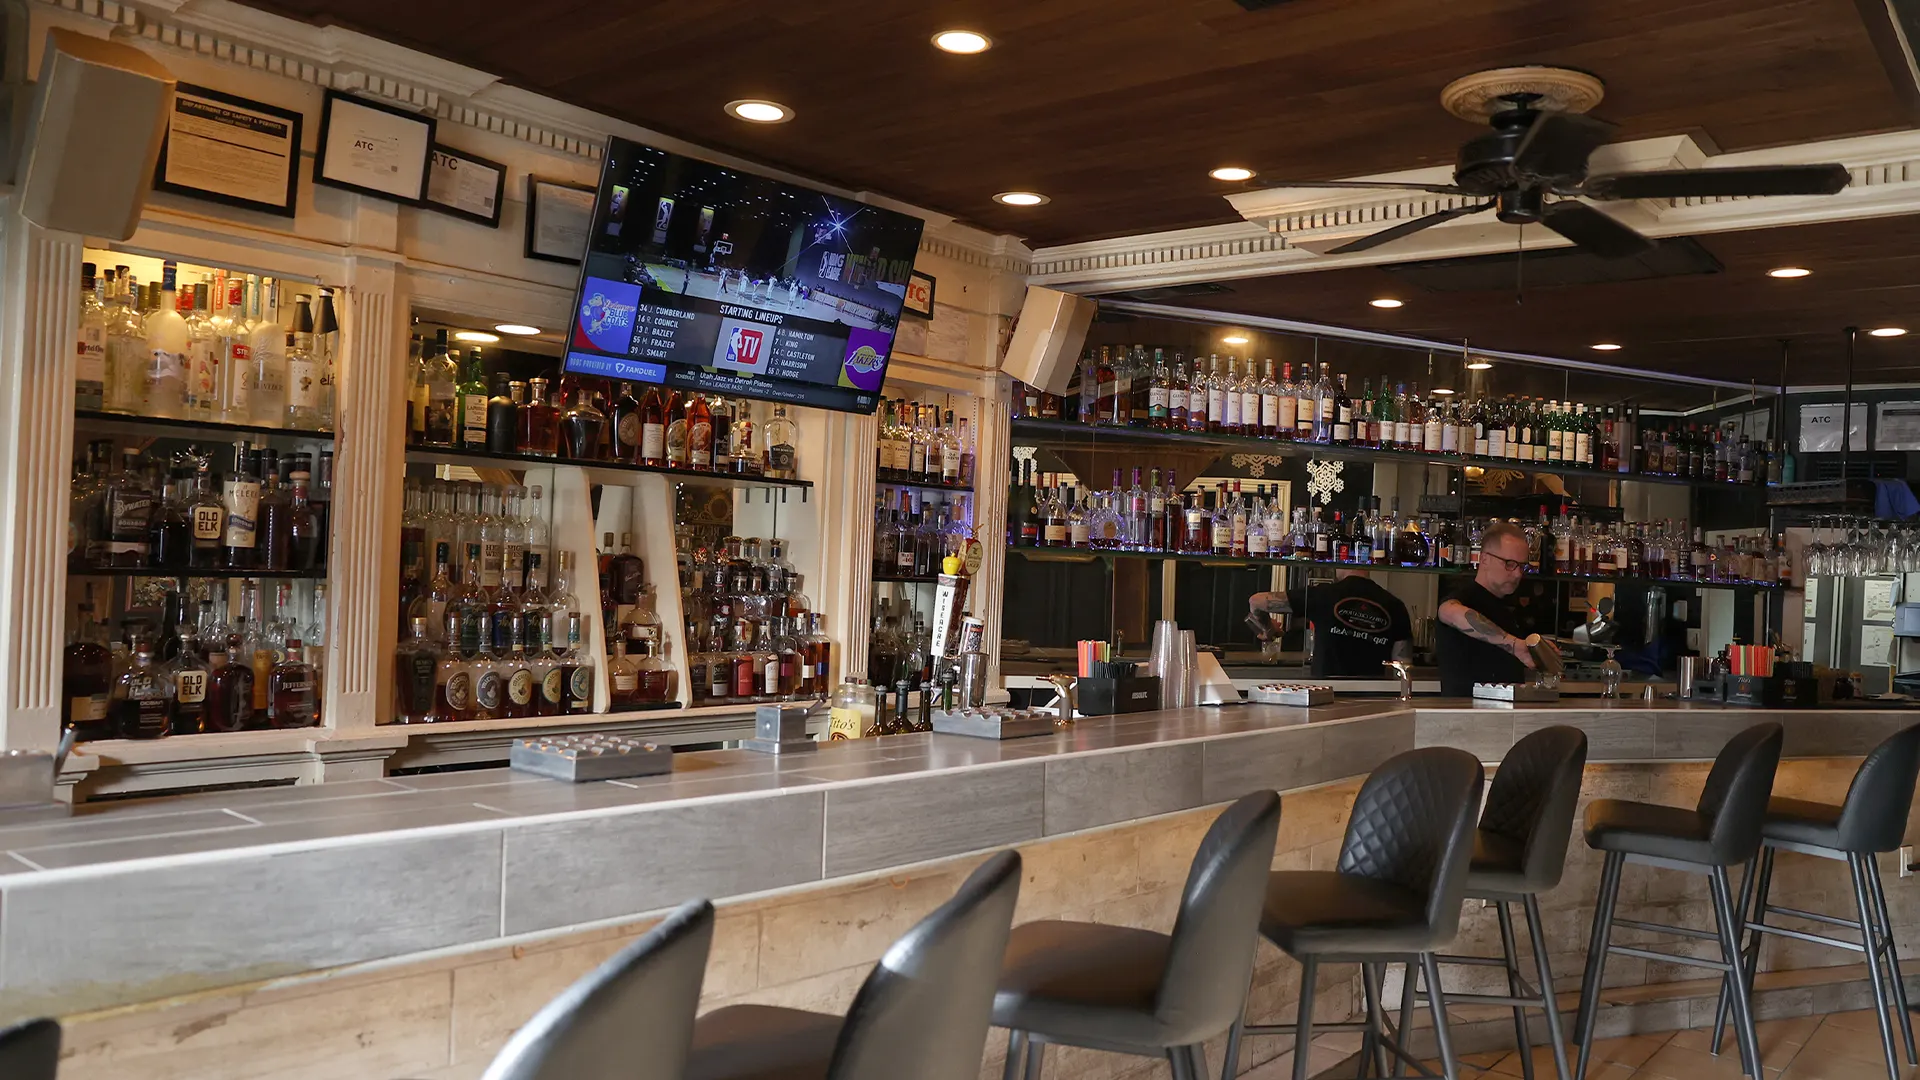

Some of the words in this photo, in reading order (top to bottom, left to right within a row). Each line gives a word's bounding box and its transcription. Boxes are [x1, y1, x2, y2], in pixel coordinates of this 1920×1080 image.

[232, 112, 253, 123] SAFETY
[354, 140, 374, 151] ATC
[431, 153, 458, 171] ATC
[908, 283, 926, 303] TC
[610, 309, 628, 319] BLUE
[640, 304, 648, 312] 34
[656, 306, 695, 320] CUMBERLAND
[719, 304, 753, 320] STARTING
[754, 310, 784, 325] LINEUPS
[606, 316, 628, 328] COATS
[638, 315, 646, 323] 16
[654, 318, 679, 328] COUNCIL
[652, 328, 674, 338] BAZLEY
[788, 331, 814, 341] HAMILTON
[632, 336, 641, 344] 55
[650, 338, 676, 350] FRAZIER
[742, 336, 760, 358] TV
[785, 340, 799, 349] KING
[630, 346, 639, 354] 39
[647, 348, 667, 358] SMART
[786, 350, 815, 361] CASTLETON
[781, 360, 808, 370] HARRISON
[845, 351, 885, 371] LAKERS
[625, 366, 657, 377] FANDUEL
[675, 372, 695, 381] SCHEDULE
[781, 369, 800, 378] HODGE
[700, 372, 714, 381] Utah
[714, 375, 727, 383] Jazz
[734, 376, 753, 386] Detroit
[753, 380, 773, 389] Pistons
[713, 381, 731, 390] LEAGUE
[1811, 416, 1831, 424] ATC
[199, 512, 218, 521] OLD
[198, 522, 217, 532] ELK
[936, 591, 949, 647] WISEACRE
[183, 675, 203, 685] OLD
[182, 685, 202, 695] ELK
[830, 716, 856, 730] Tito's
